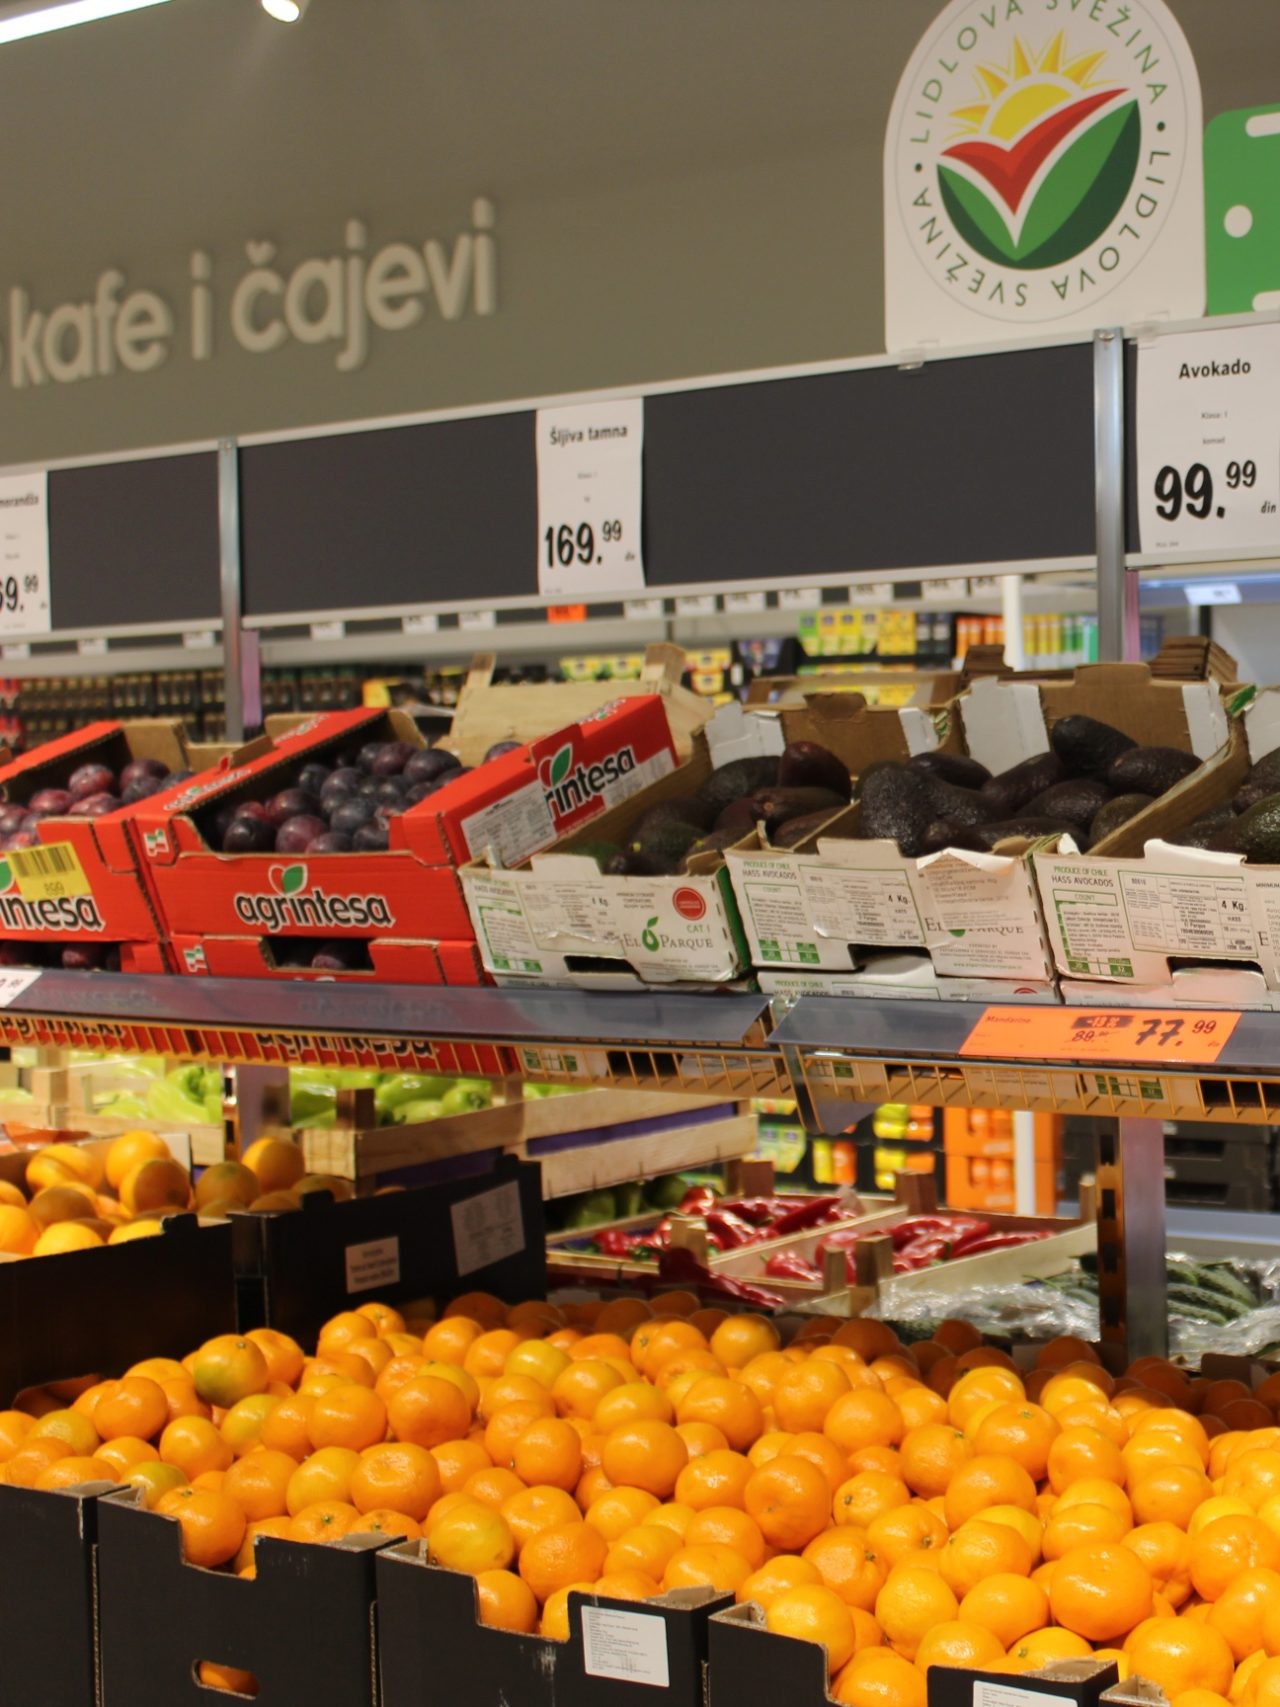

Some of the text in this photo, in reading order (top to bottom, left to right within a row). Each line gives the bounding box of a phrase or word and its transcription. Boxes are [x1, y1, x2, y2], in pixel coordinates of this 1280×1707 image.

[909, 0, 1024, 144] LIDLOVA
[912, 150, 1171, 307] LIDLOVA SVEŽINA
[10, 197, 497, 389] kafe i čajevi
[1178, 359, 1252, 380] Avokado
[549, 425, 628, 448] Šljiva tamna
[1154, 460, 1277, 521] 99. 99 din
[545, 522, 603, 569] 169.
[602, 519, 623, 542] 99
[1052, 875, 1114, 888] HASS AVOCADOS
[235, 887, 396, 933] agrintesa
[968, 926, 1025, 937] ARQUE
[1135, 1019, 1185, 1047] 77.
[1191, 1020, 1217, 1035] 99
